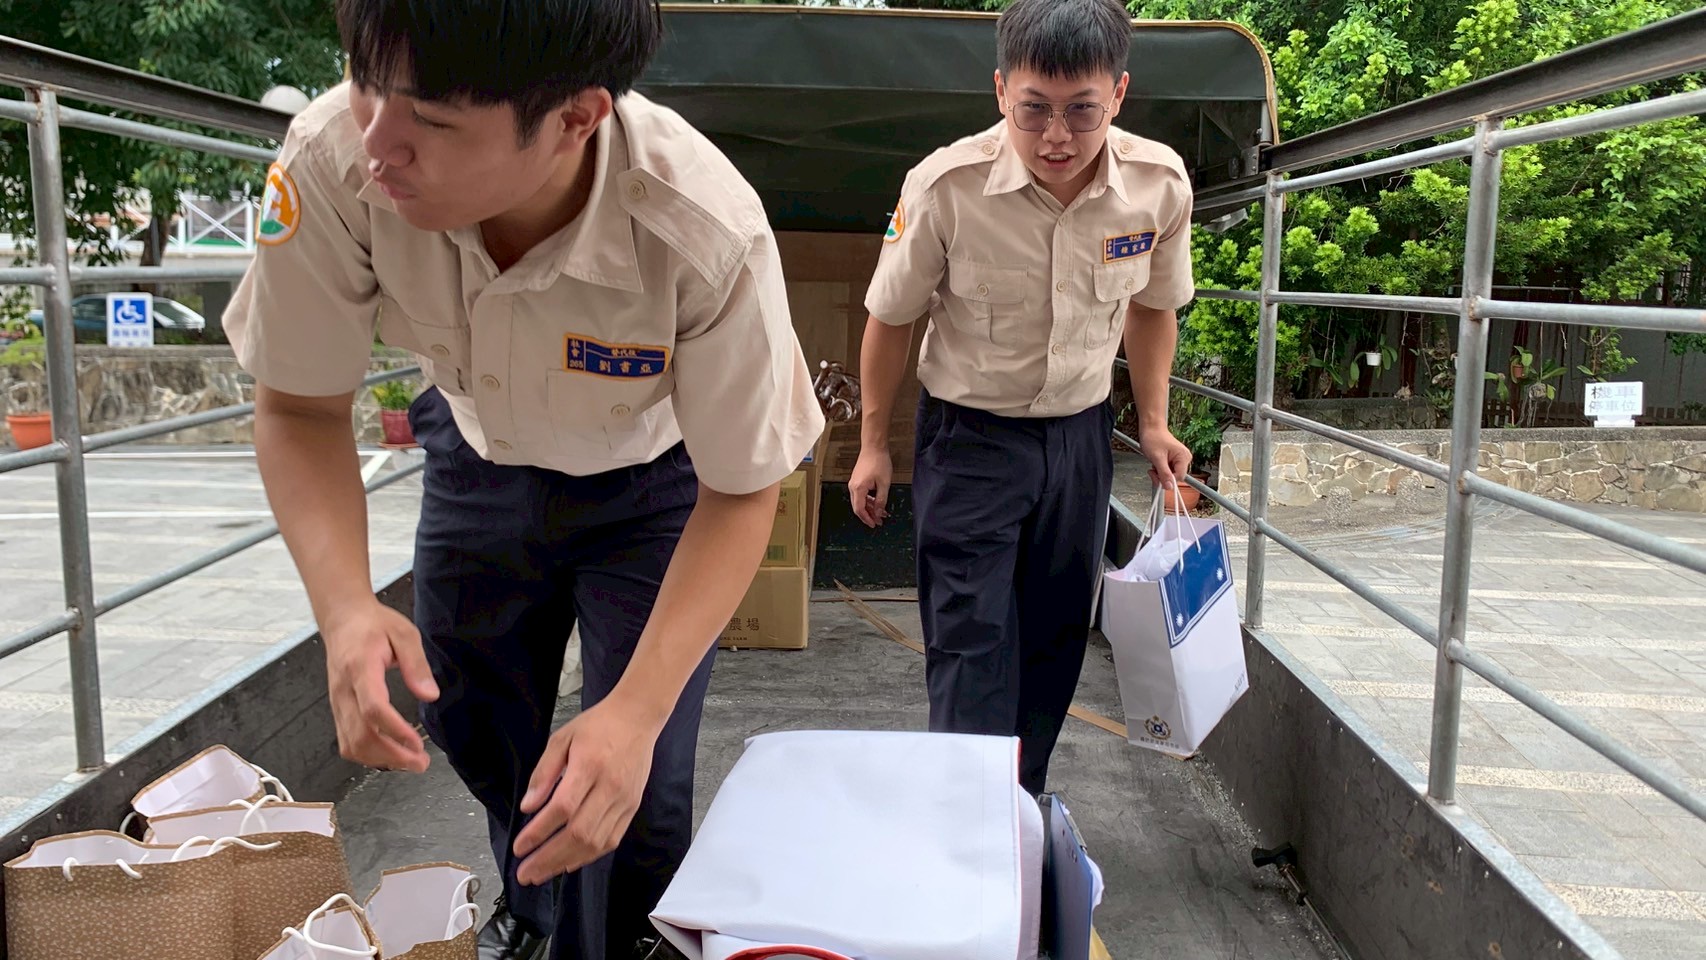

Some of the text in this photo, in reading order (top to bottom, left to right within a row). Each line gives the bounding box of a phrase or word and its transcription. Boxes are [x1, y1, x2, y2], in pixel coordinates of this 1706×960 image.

[1591, 385, 1637, 399] 機車
[1589, 400, 1637, 413] 停車位
[729, 617, 760, 631] 農場
